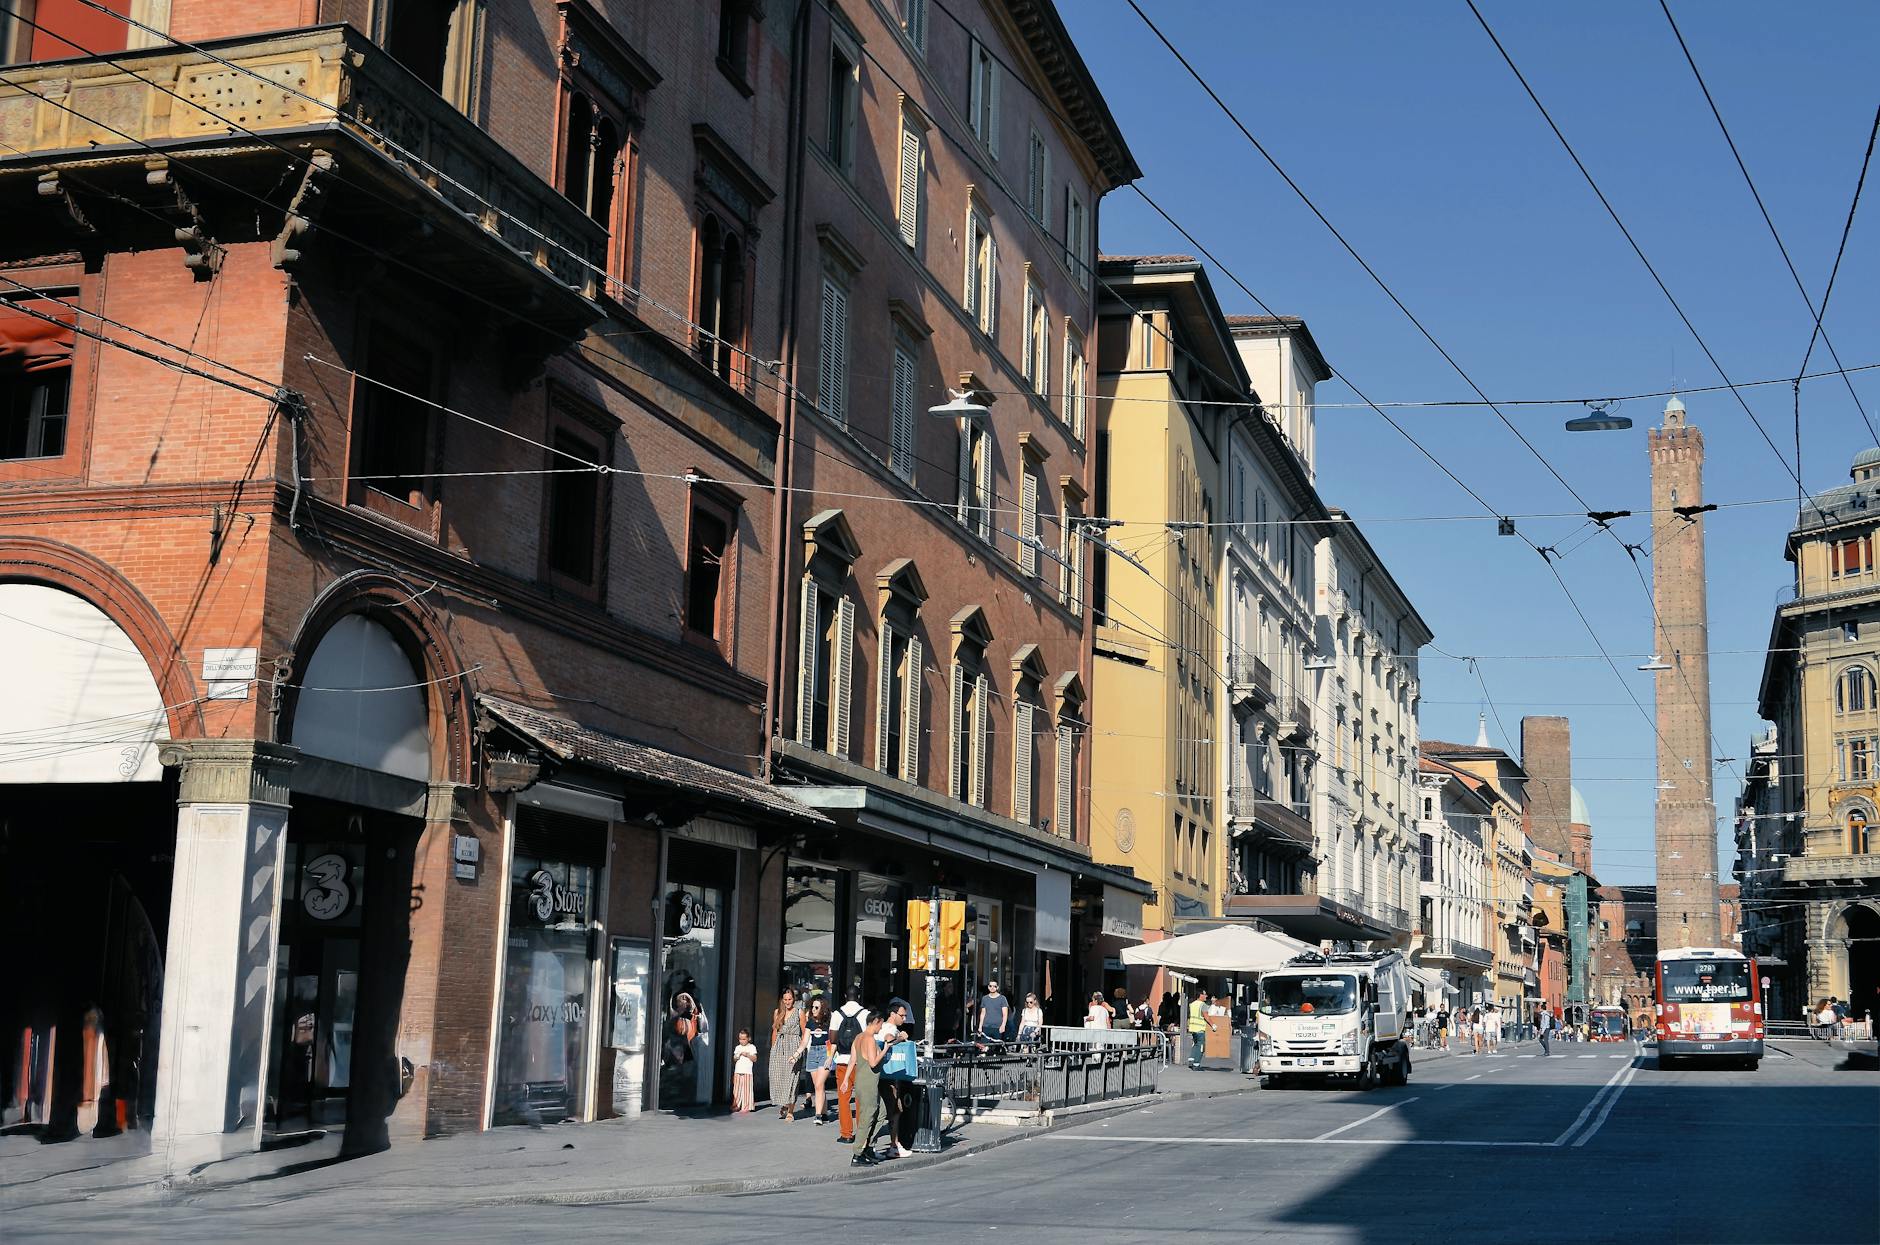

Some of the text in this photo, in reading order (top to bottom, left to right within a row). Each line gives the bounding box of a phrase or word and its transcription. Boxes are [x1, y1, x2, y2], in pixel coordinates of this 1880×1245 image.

[1850, 499, 1867, 510] 14
[304, 854, 350, 920] 3
[530, 871, 584, 919] 3 Store
[680, 893, 717, 934] 3 Store
[864, 898, 894, 917] GEOX
[1674, 982, 1740, 997] www.tper.it
